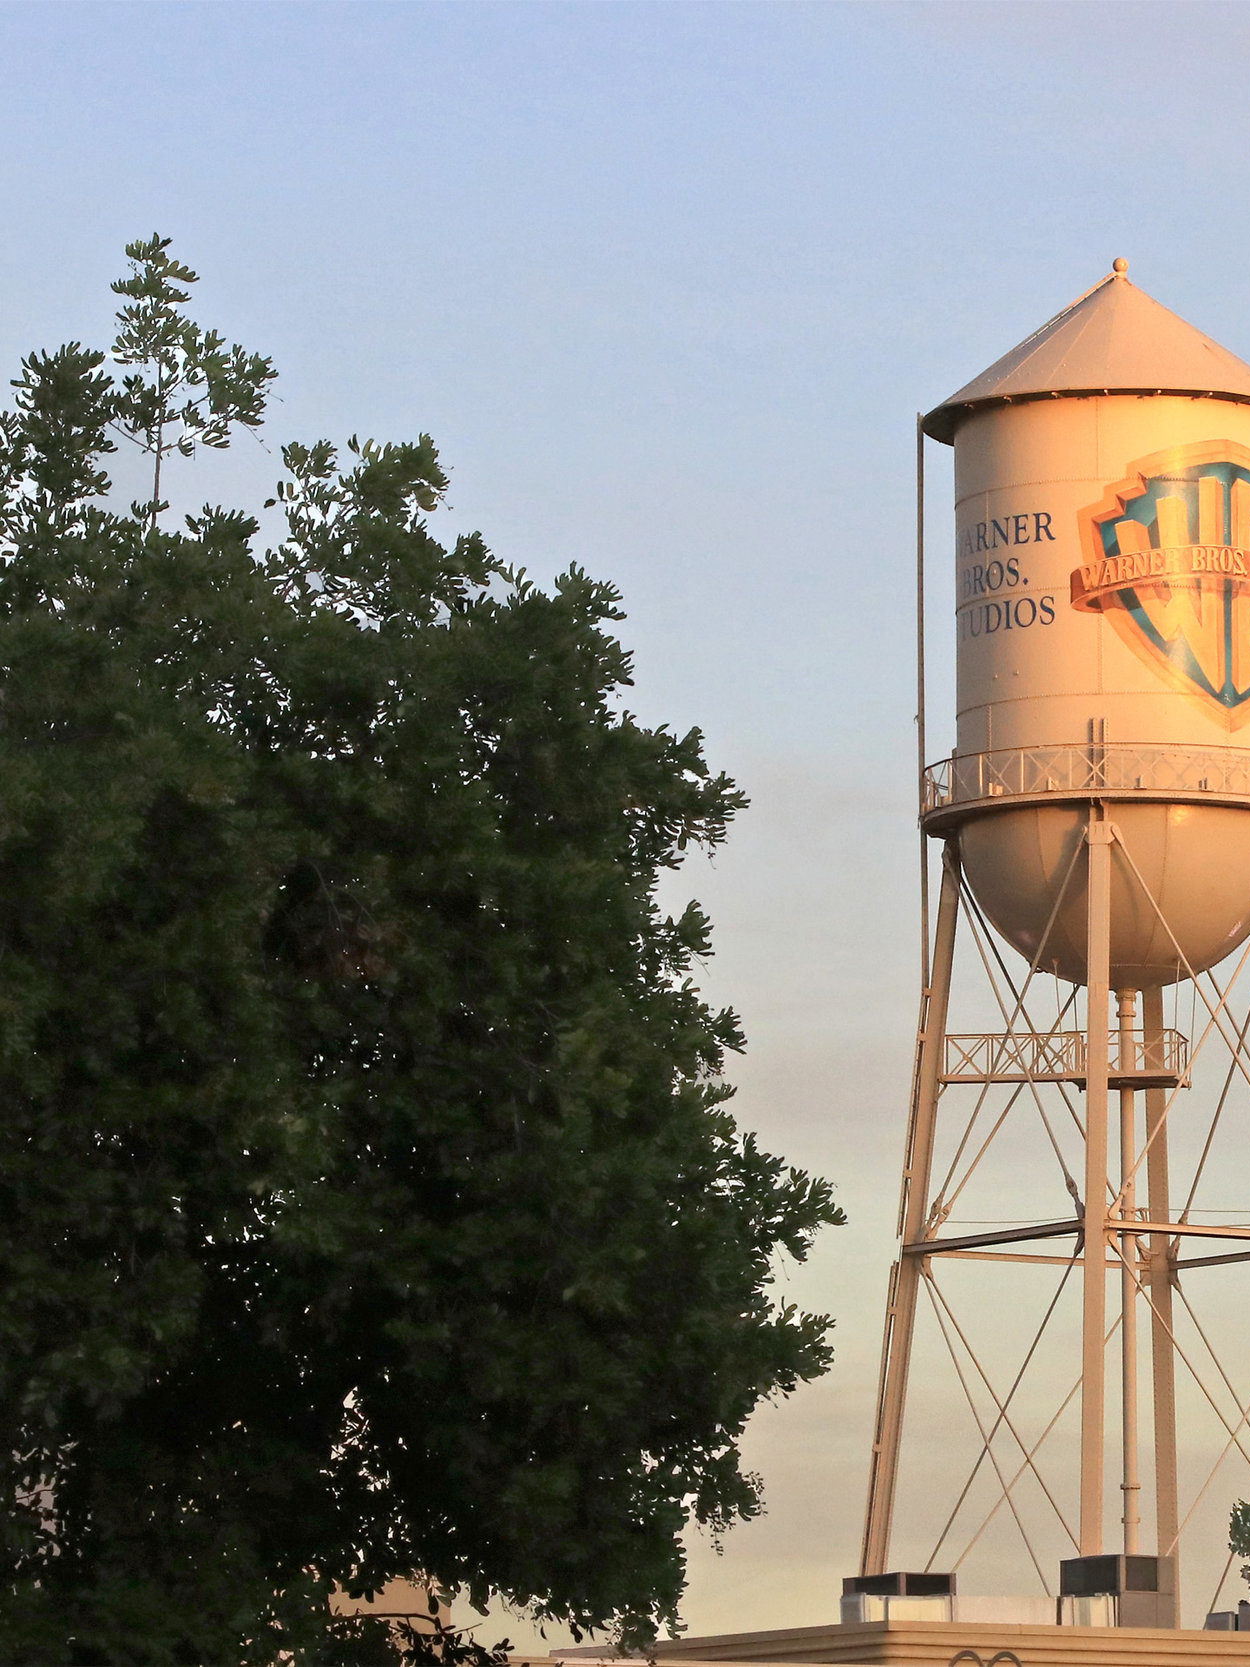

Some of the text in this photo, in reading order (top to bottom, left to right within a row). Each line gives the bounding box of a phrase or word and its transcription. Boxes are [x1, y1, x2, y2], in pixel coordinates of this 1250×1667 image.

[959, 512, 1056, 556] ARNER
[963, 558, 1028, 598] BROS.
[1079, 549, 1181, 591] WARNER
[961, 596, 1055, 641] TUDIOS
